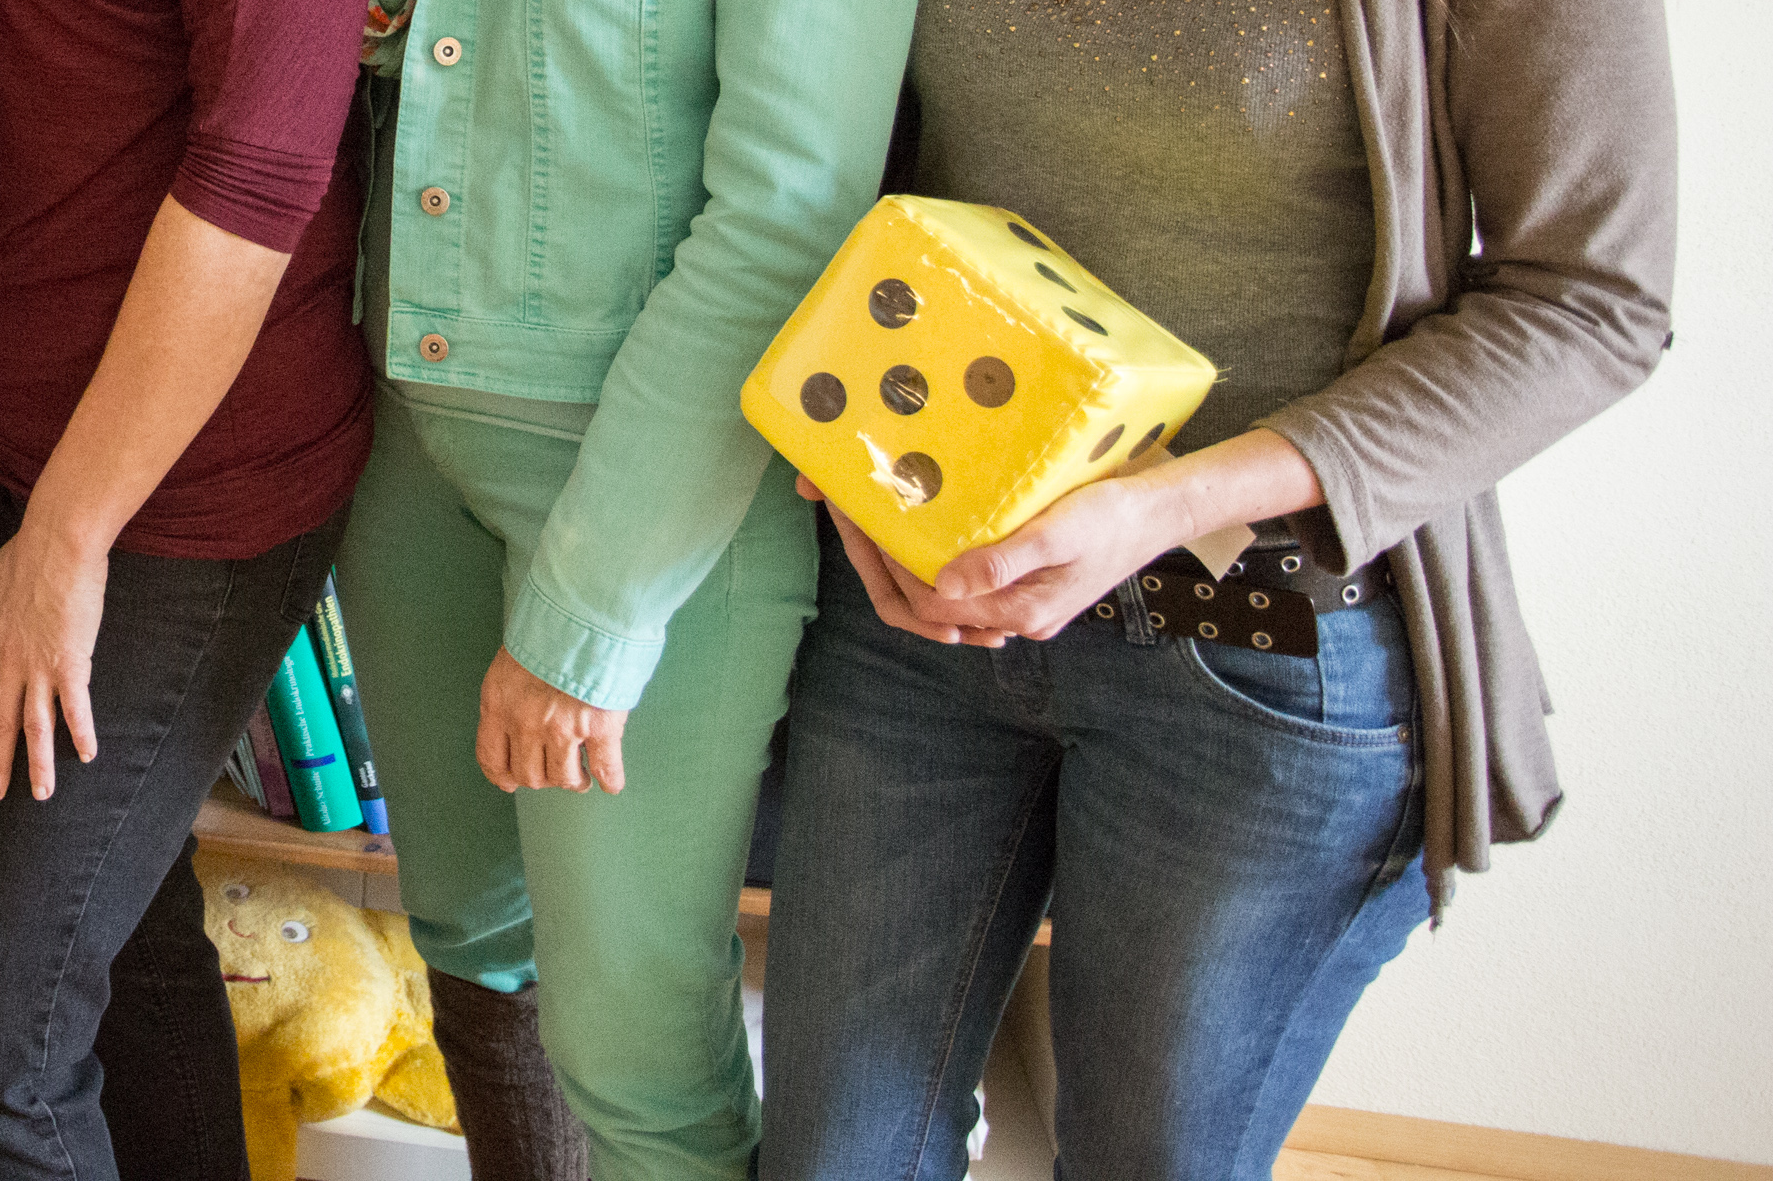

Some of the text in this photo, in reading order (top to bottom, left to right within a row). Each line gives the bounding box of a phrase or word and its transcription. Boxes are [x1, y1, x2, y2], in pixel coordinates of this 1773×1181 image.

[325, 595, 353, 678] Endokrinopathien
[284, 654, 314, 758] Praktische Endokrinologie
